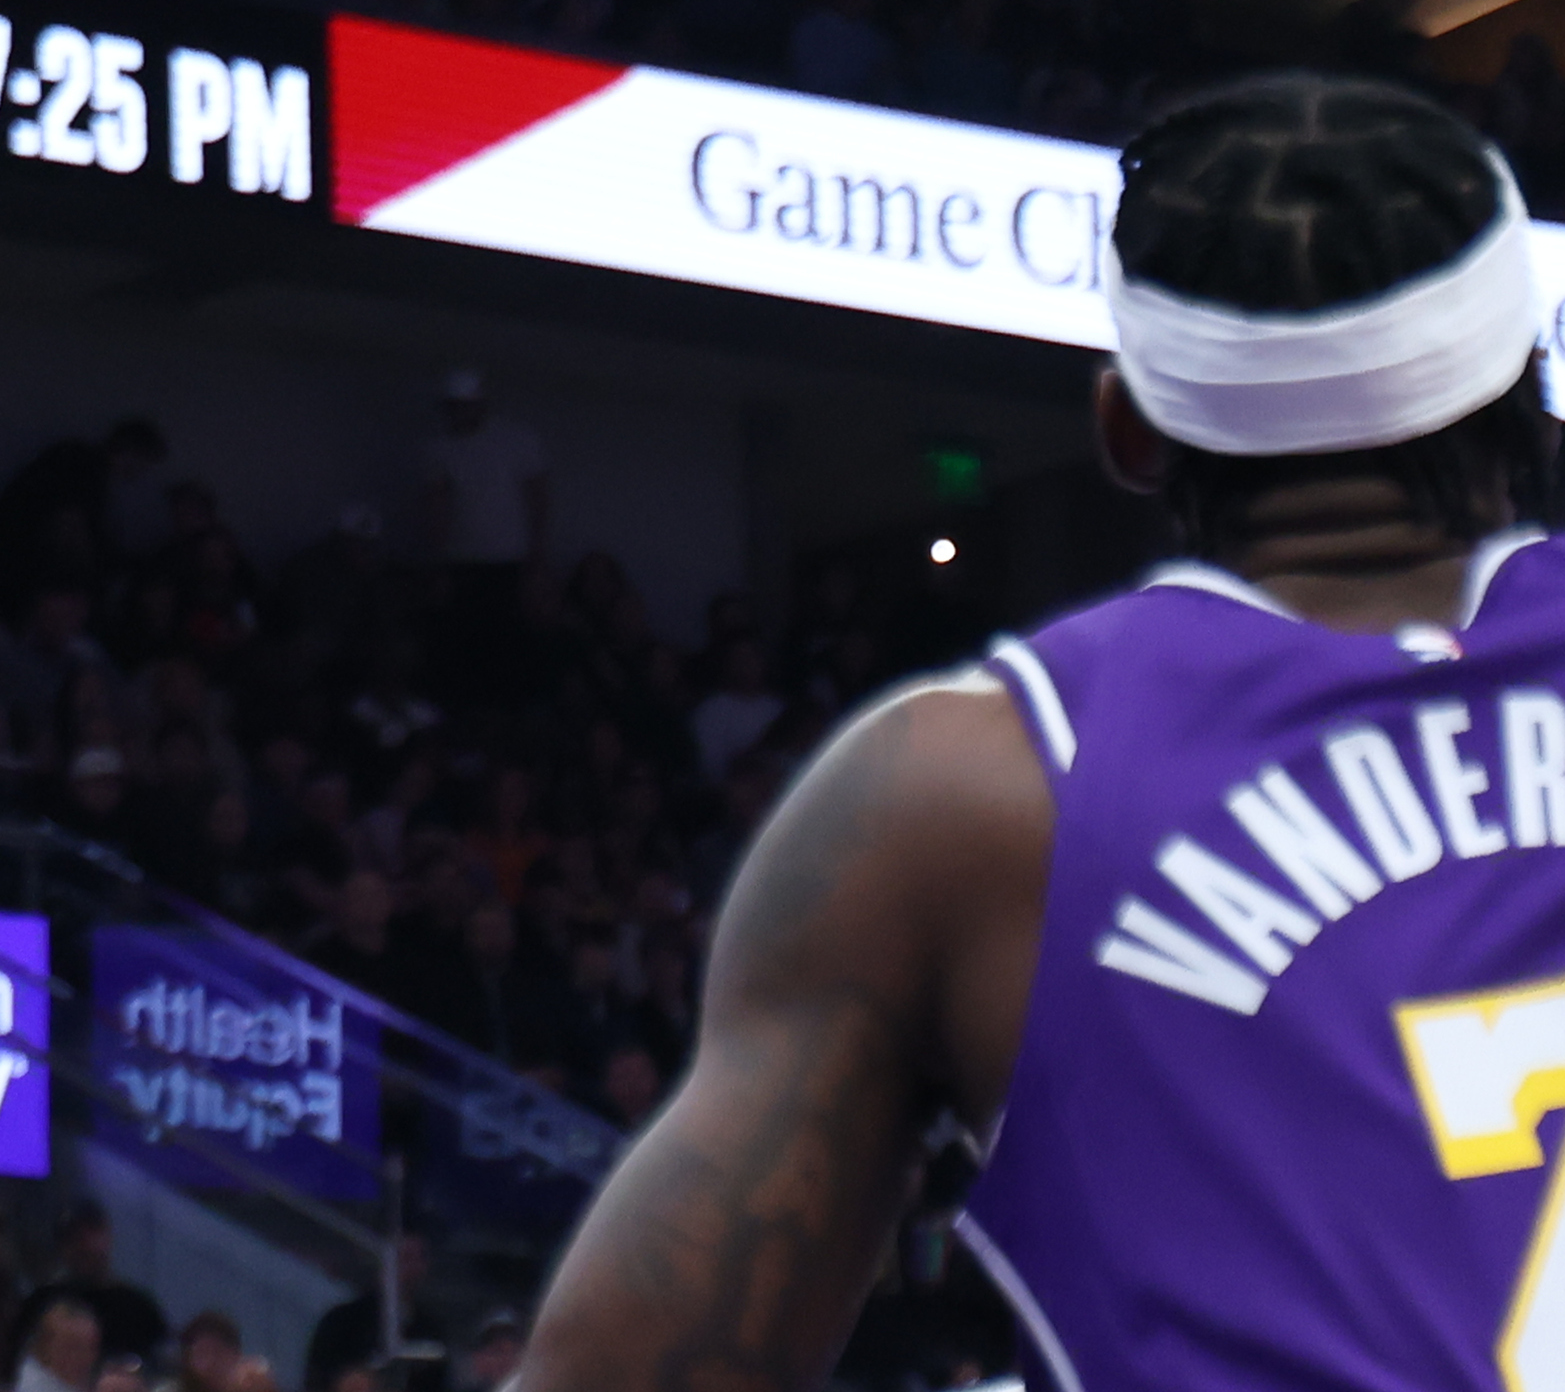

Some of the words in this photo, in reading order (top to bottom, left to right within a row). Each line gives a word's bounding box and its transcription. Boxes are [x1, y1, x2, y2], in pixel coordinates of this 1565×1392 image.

[0, 14, 149, 175] :25
[166, 45, 313, 202] PM
[690, 129, 987, 270] Game
